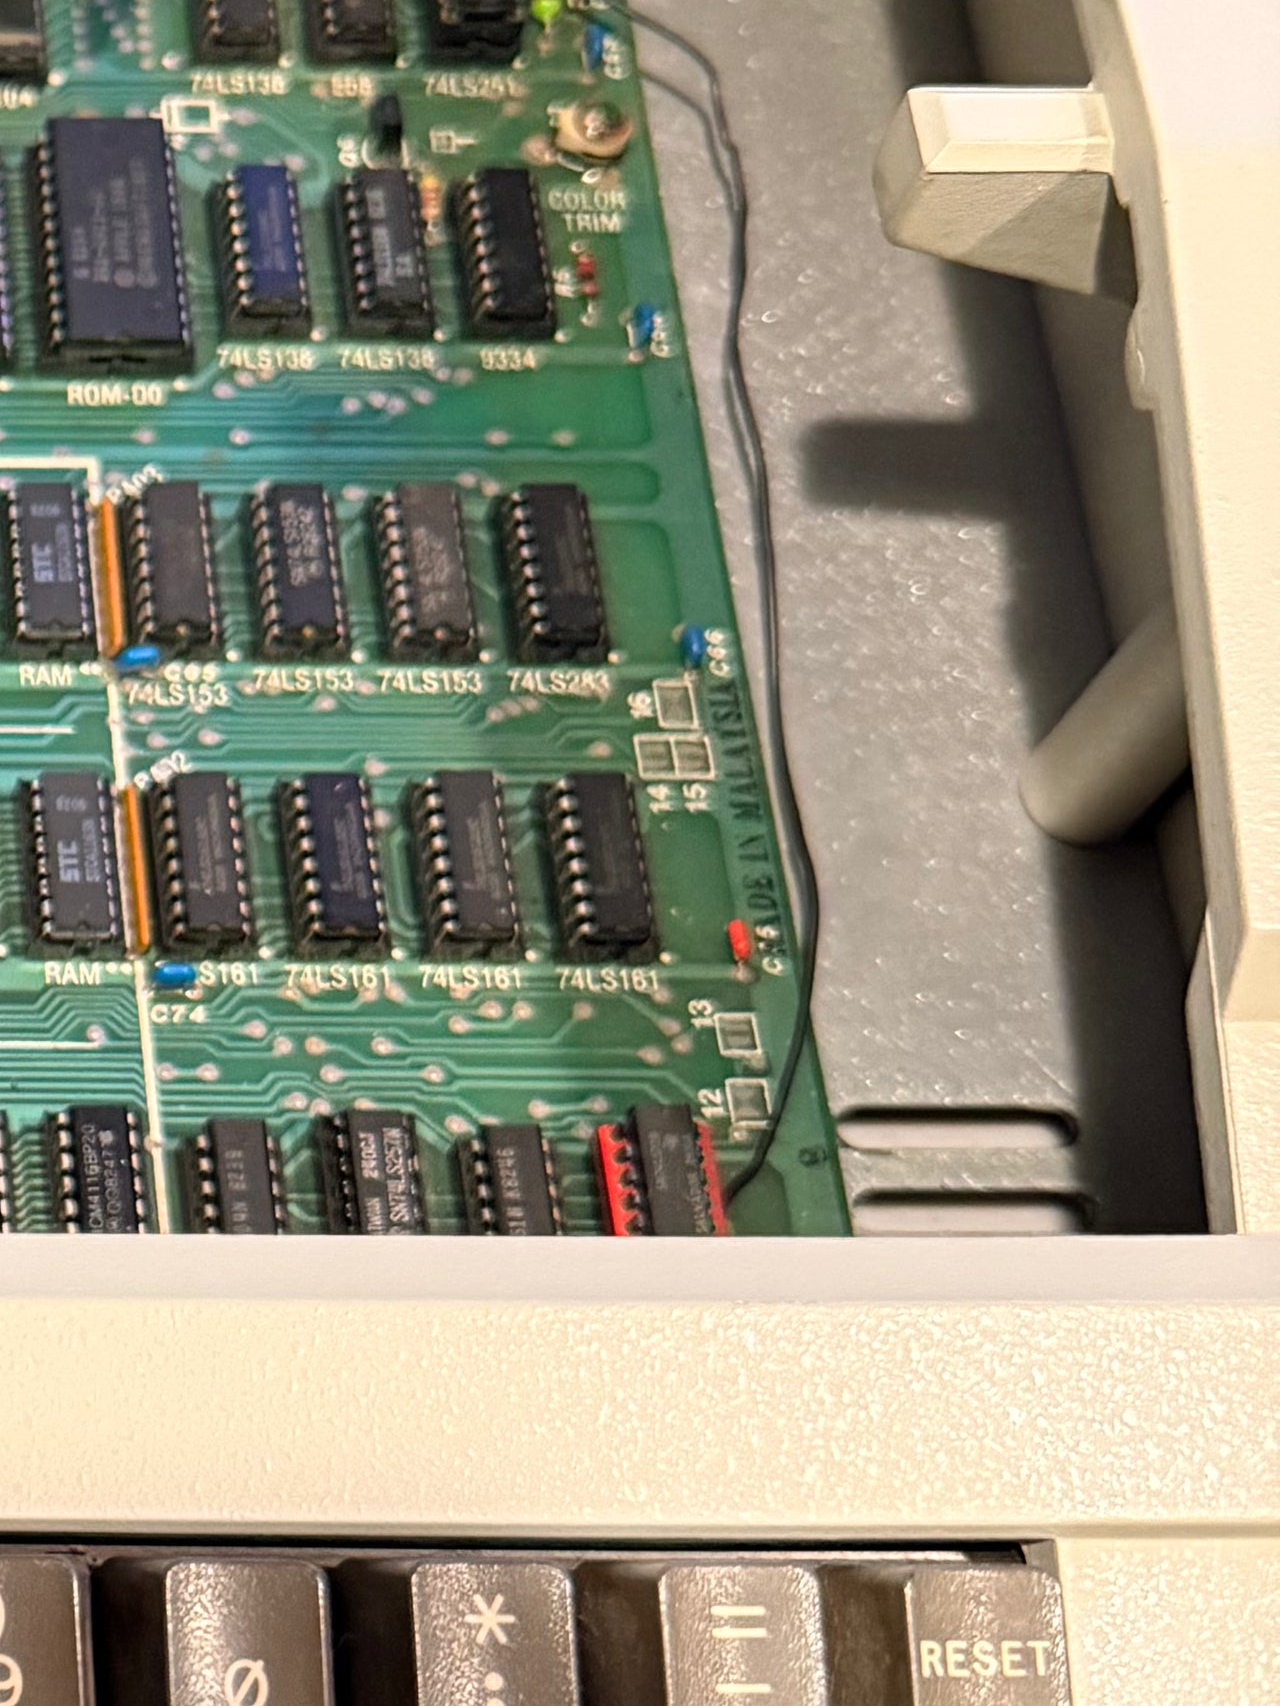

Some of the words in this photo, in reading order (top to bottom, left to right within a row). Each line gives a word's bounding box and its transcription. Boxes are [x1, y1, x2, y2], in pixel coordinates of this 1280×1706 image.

[548, 190, 627, 211] COLOR
[561, 214, 622, 234] TRIM
[253, 671, 354, 692] 74LS153
[378, 671, 483, 693] 74LS153
[507, 671, 610, 692] 74LS283
[128, 684, 228, 706] 74LS153
[685, 783, 709, 811] 15
[285, 966, 391, 988] 74LS161
[420, 966, 522, 988] 74LS161
[557, 968, 659, 991] 74LS161
[150, 1007, 205, 1024] C74
[690, 1000, 713, 1028] 13
[699, 1089, 724, 1118] 12
[920, 1639, 1051, 1679] RESET
